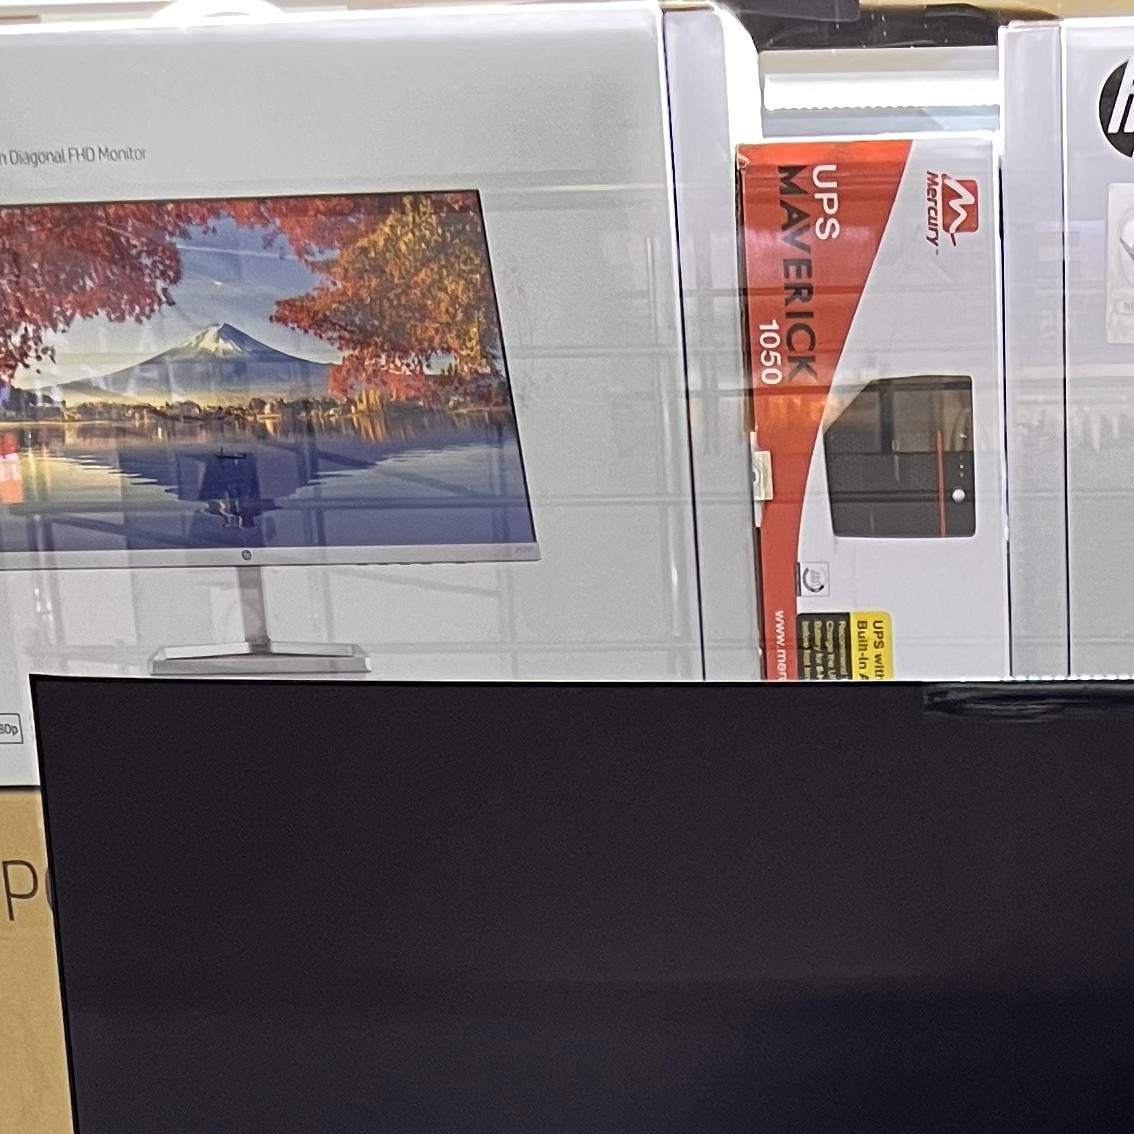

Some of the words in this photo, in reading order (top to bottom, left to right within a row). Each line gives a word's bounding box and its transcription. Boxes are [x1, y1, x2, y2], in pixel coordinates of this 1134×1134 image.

[8, 149, 66, 168] Diagonal
[68, 147, 95, 163] FHD
[98, 145, 147, 162] Monitor
[812, 164, 840, 240] UPS
[926, 170, 939, 247] Mercury
[778, 164, 818, 382] MAVERICK
[759, 319, 783, 385] 1050
[873, 620, 885, 649] UPS
